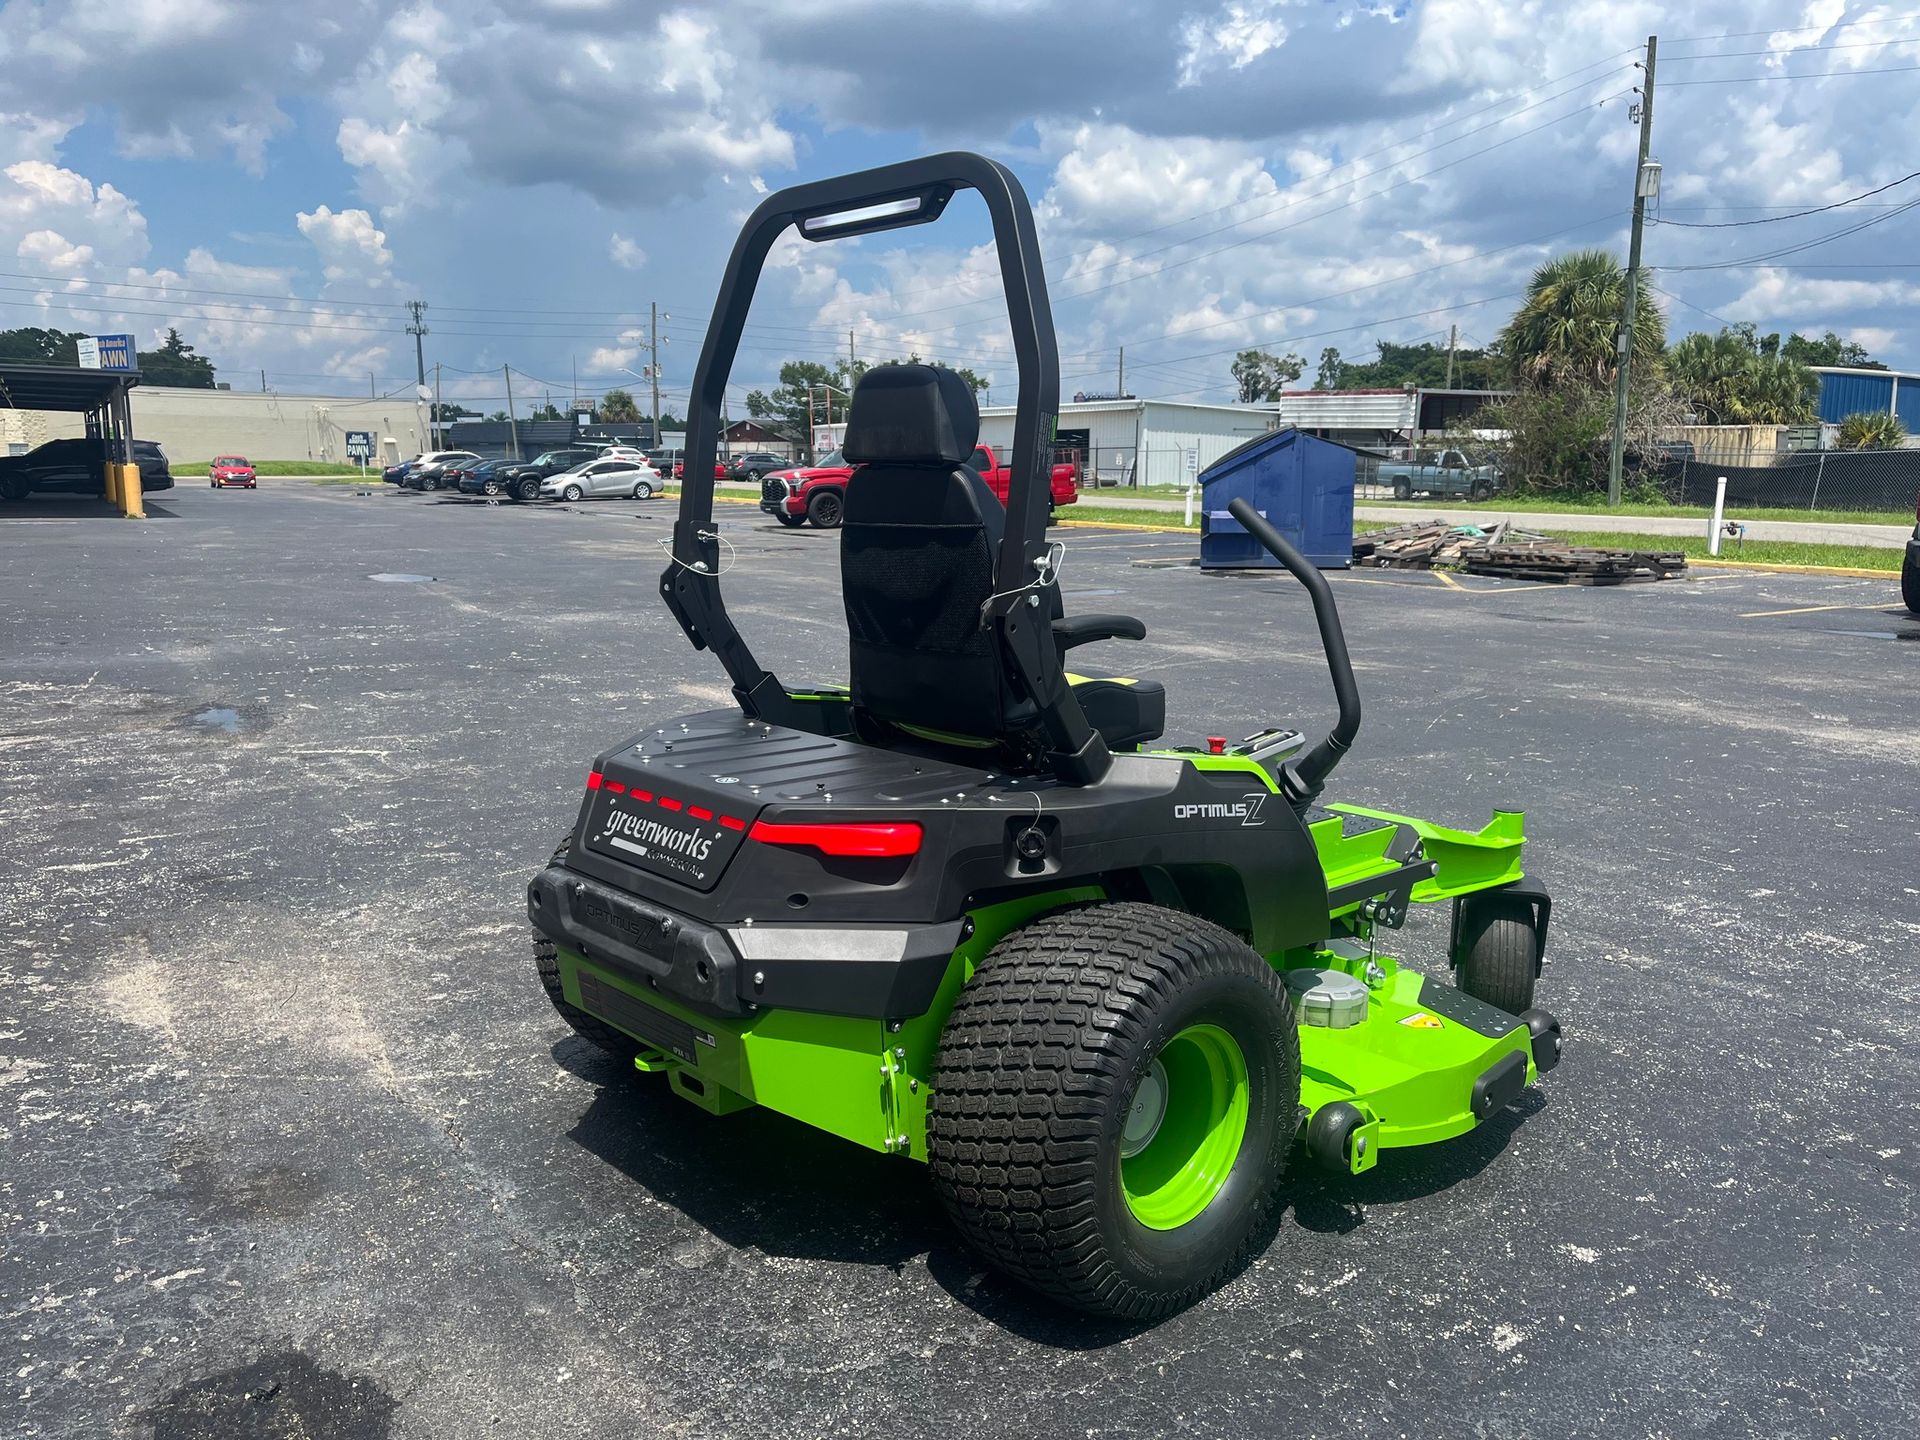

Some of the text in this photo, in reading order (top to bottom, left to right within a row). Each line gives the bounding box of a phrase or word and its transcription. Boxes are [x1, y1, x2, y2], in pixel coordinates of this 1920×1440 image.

[99, 349, 127, 368] AWN
[347, 444, 369, 456] PAWN
[602, 809, 712, 861] greenworks
